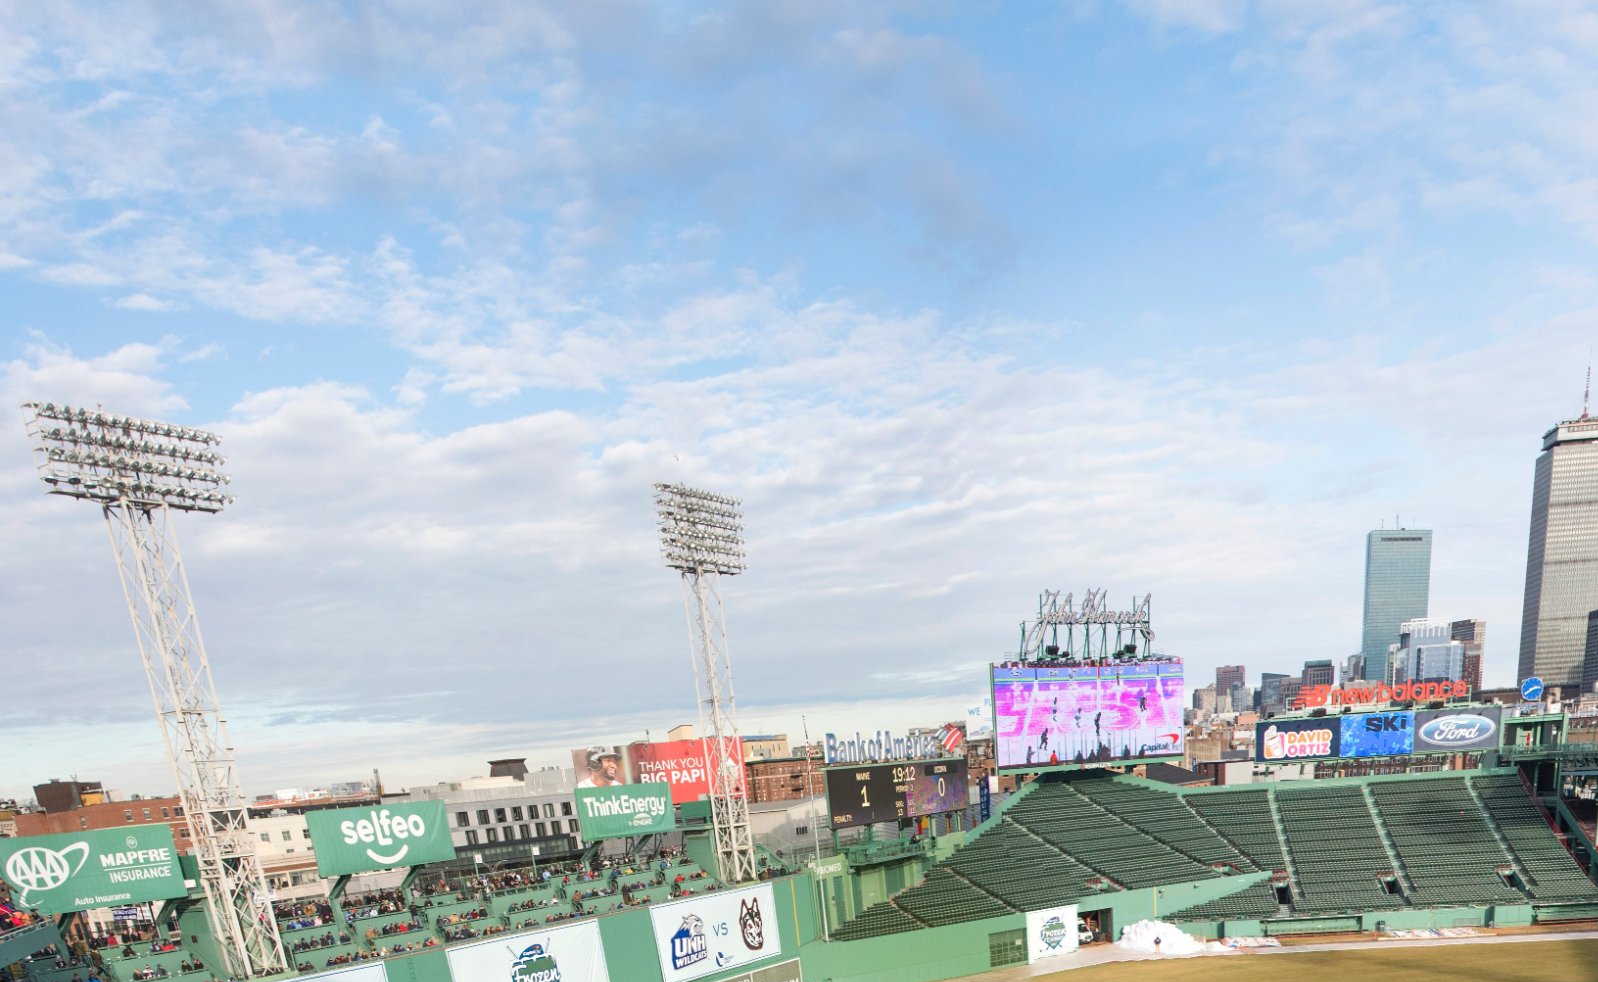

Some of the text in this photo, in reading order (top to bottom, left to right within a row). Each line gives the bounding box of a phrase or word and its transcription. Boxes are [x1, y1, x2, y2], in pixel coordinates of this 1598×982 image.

[1025, 587, 1155, 654] John Hancock
[1331, 679, 1468, 705] new balance
[1365, 715, 1407, 733] SKi
[1434, 720, 1479, 740] Ford
[1287, 729, 1333, 744] DAVID
[825, 730, 938, 764] Bank of America
[1287, 742, 1331, 756] ORTIZ
[638, 757, 704, 773] THANK YOU
[641, 768, 706, 785] BIG PAPI
[855, 771, 870, 781] MAINE
[892, 766, 916, 783] 19:12
[860, 785, 871, 807] 1
[938, 777, 946, 797] 0
[583, 793, 665, 818] ThinkEnergy
[100, 848, 171, 867] MAPFRE
[16, 850, 66, 888] AAA
[109, 866, 172, 884] INSURANCE
[75, 892, 131, 906] Auto Insurance
[712, 922, 729, 937] VS
[674, 935, 706, 958] UNH
[675, 951, 708, 969] WILDCATS
